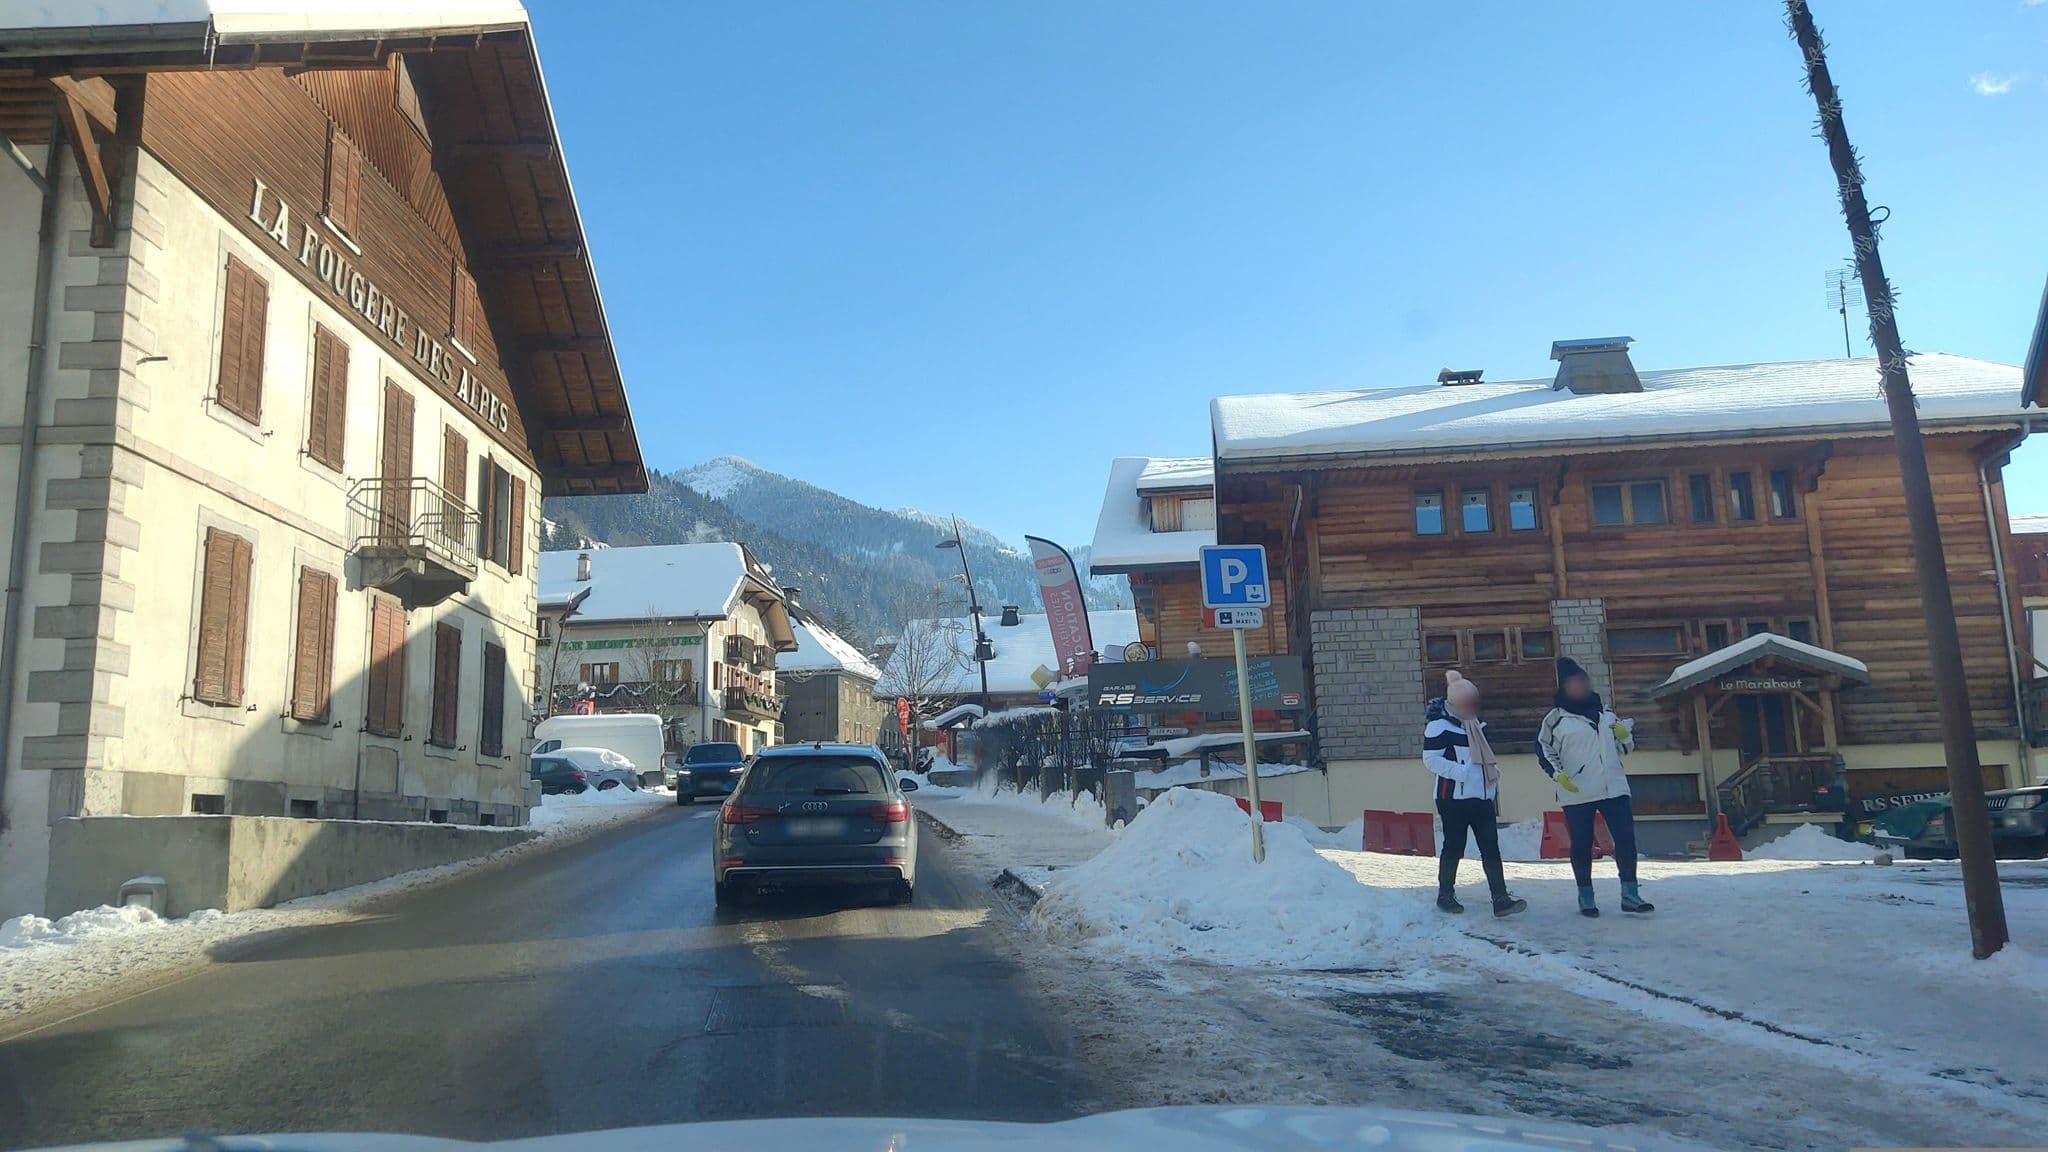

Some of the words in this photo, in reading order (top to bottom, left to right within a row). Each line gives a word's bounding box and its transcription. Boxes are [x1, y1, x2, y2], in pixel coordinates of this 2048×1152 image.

[249, 176, 289, 250] LA
[299, 221, 409, 348] FOUGERE
[414, 326, 454, 385] DES
[456, 366, 510, 433] ALPES
[1220, 558, 1247, 595] P
[1721, 681, 1733, 690] Le
